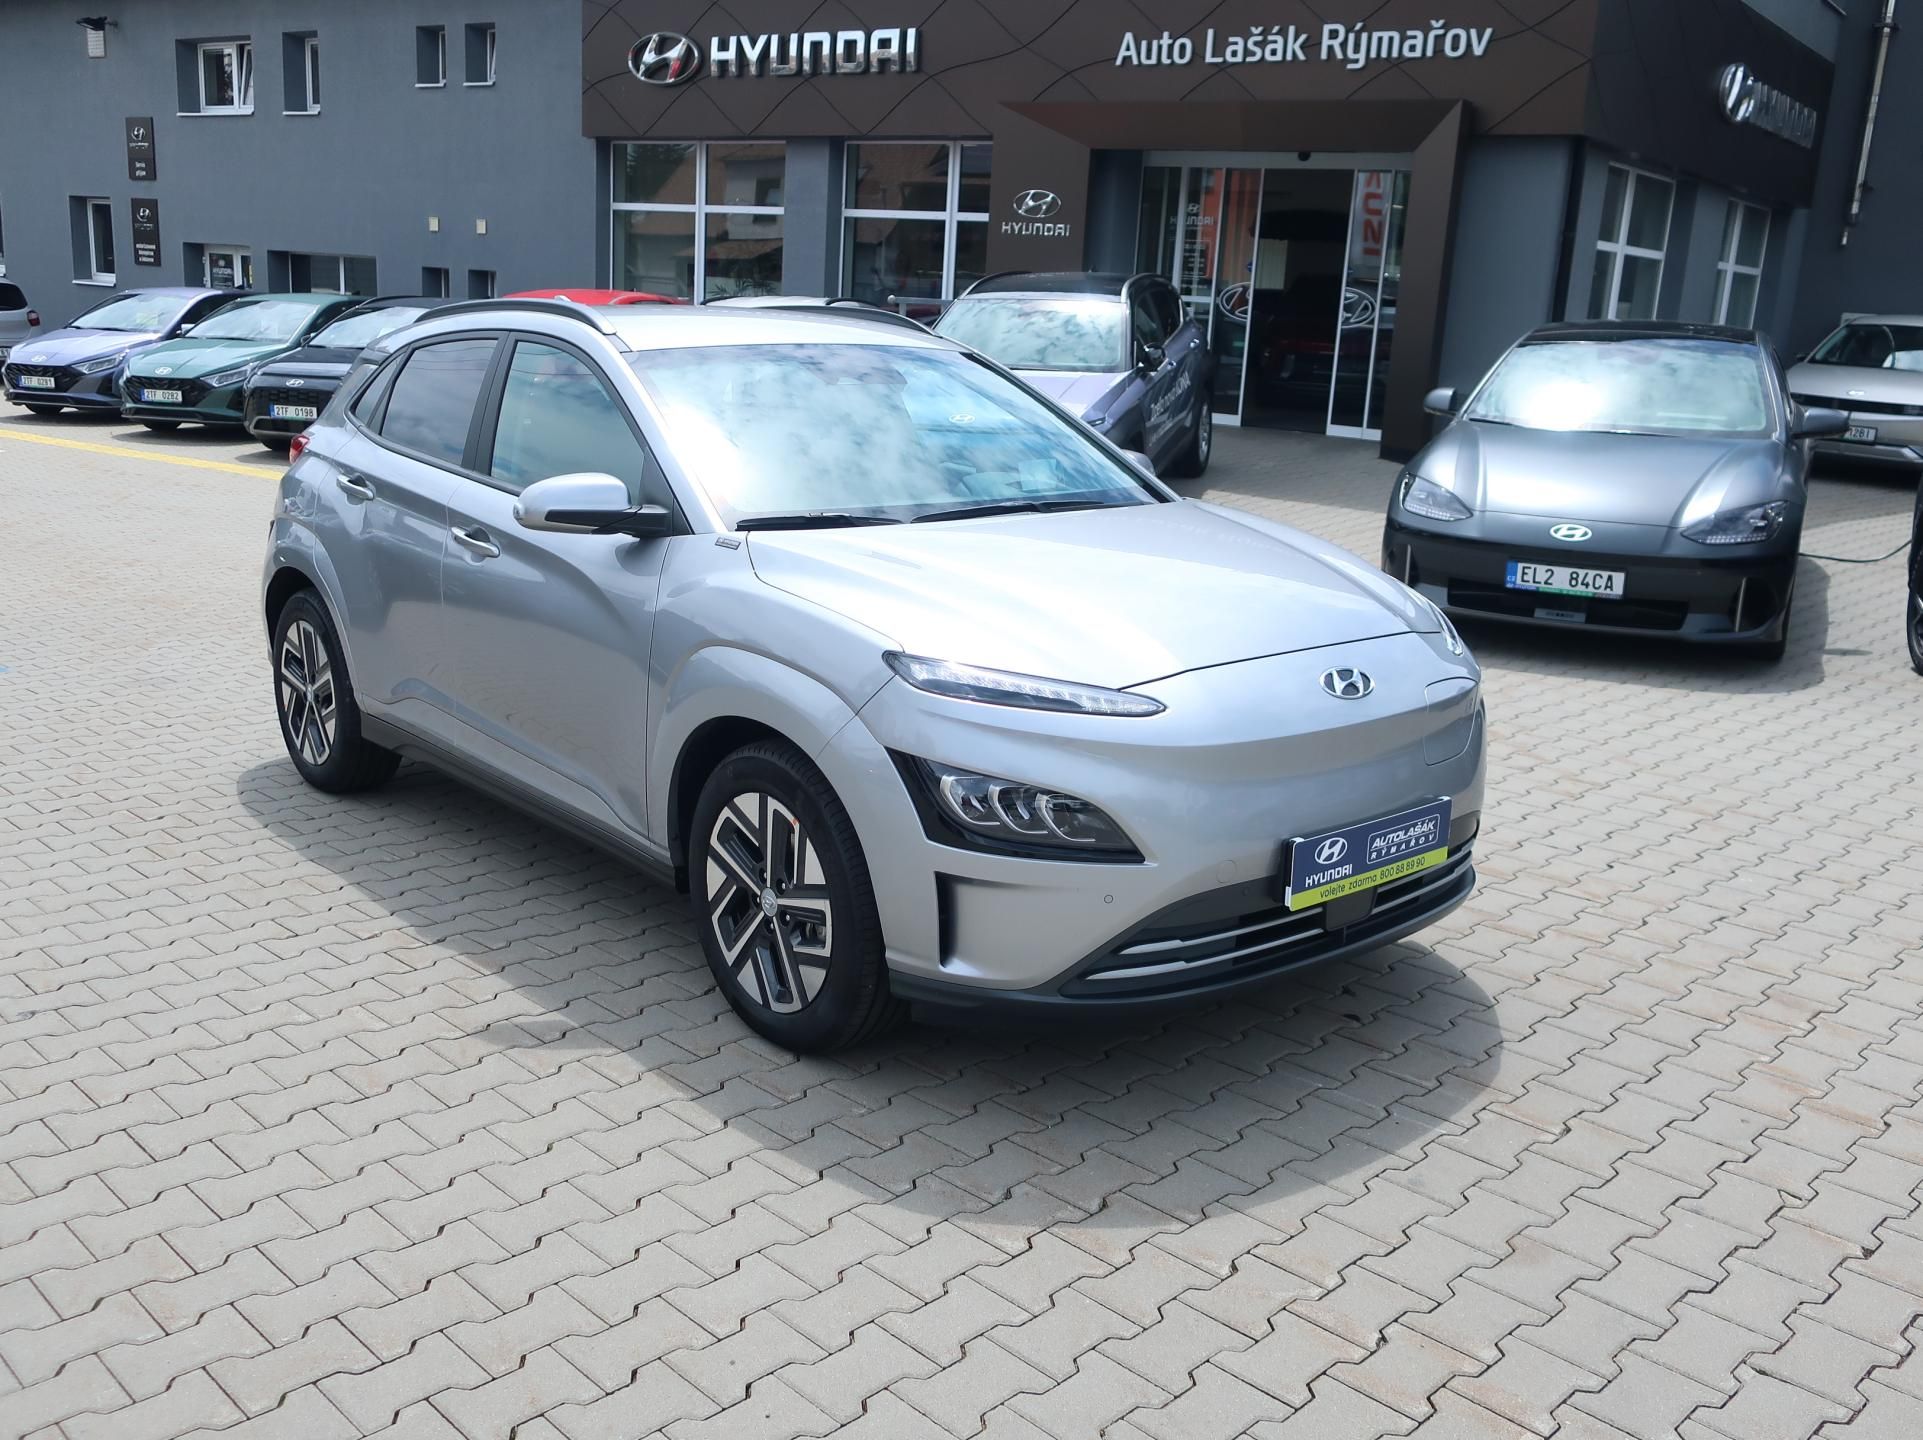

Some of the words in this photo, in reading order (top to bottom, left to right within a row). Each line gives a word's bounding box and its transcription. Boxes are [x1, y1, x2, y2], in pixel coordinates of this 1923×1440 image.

[709, 27, 917, 77] HYUNDAI
[1114, 31, 1193, 66] Auto
[1204, 24, 1309, 64] Lašák
[1319, 19, 1494, 71] Rýmařov
[1001, 221, 1070, 237] HYUNDAI
[275, 406, 288, 416] 2TF
[294, 407, 314, 417] 0198
[1520, 566, 1555, 586] EL2
[1568, 571, 1614, 592] 84CA
[1371, 819, 1436, 849] AUTOLAŠÁK
[1305, 863, 1353, 888] HYUNDAI
[1320, 885, 1346, 899] volejte
[1348, 875, 1377, 890] zdarma
[1379, 868, 1395, 880] 800
[1395, 864, 1405, 875] 88
[1405, 861, 1415, 873] 89
[1415, 856, 1426, 868] 90
